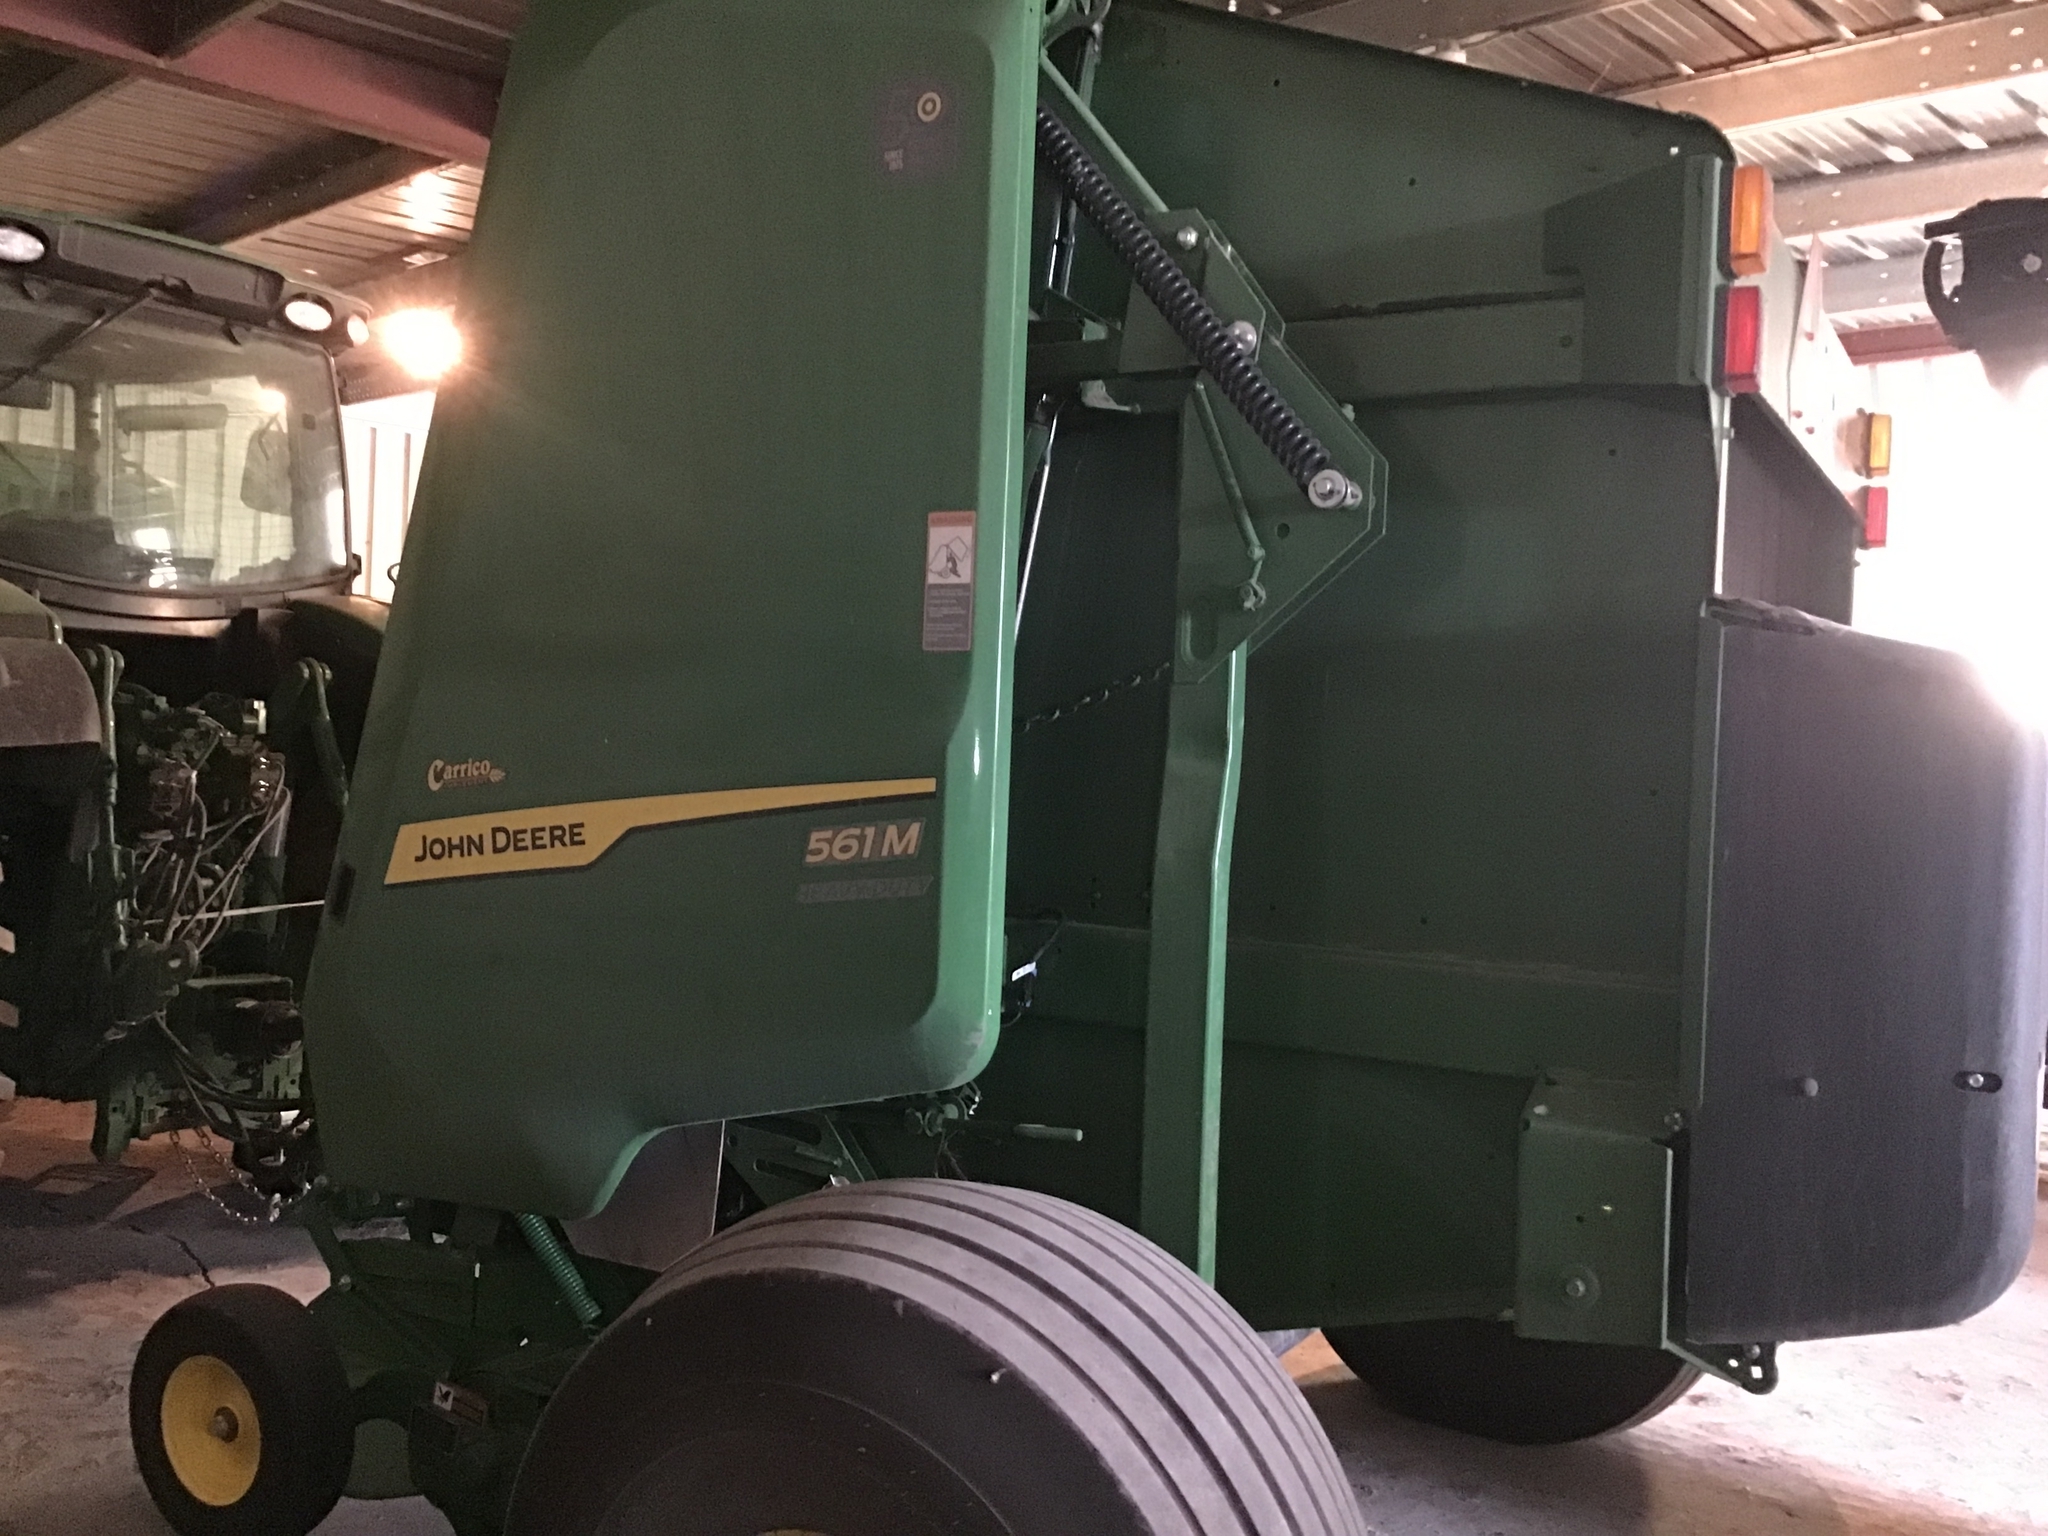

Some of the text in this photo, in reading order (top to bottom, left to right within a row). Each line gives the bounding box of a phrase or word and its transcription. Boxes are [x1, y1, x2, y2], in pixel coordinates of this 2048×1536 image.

[428, 758, 489, 791] Carrico
[414, 822, 586, 862] JOHN DEERE
